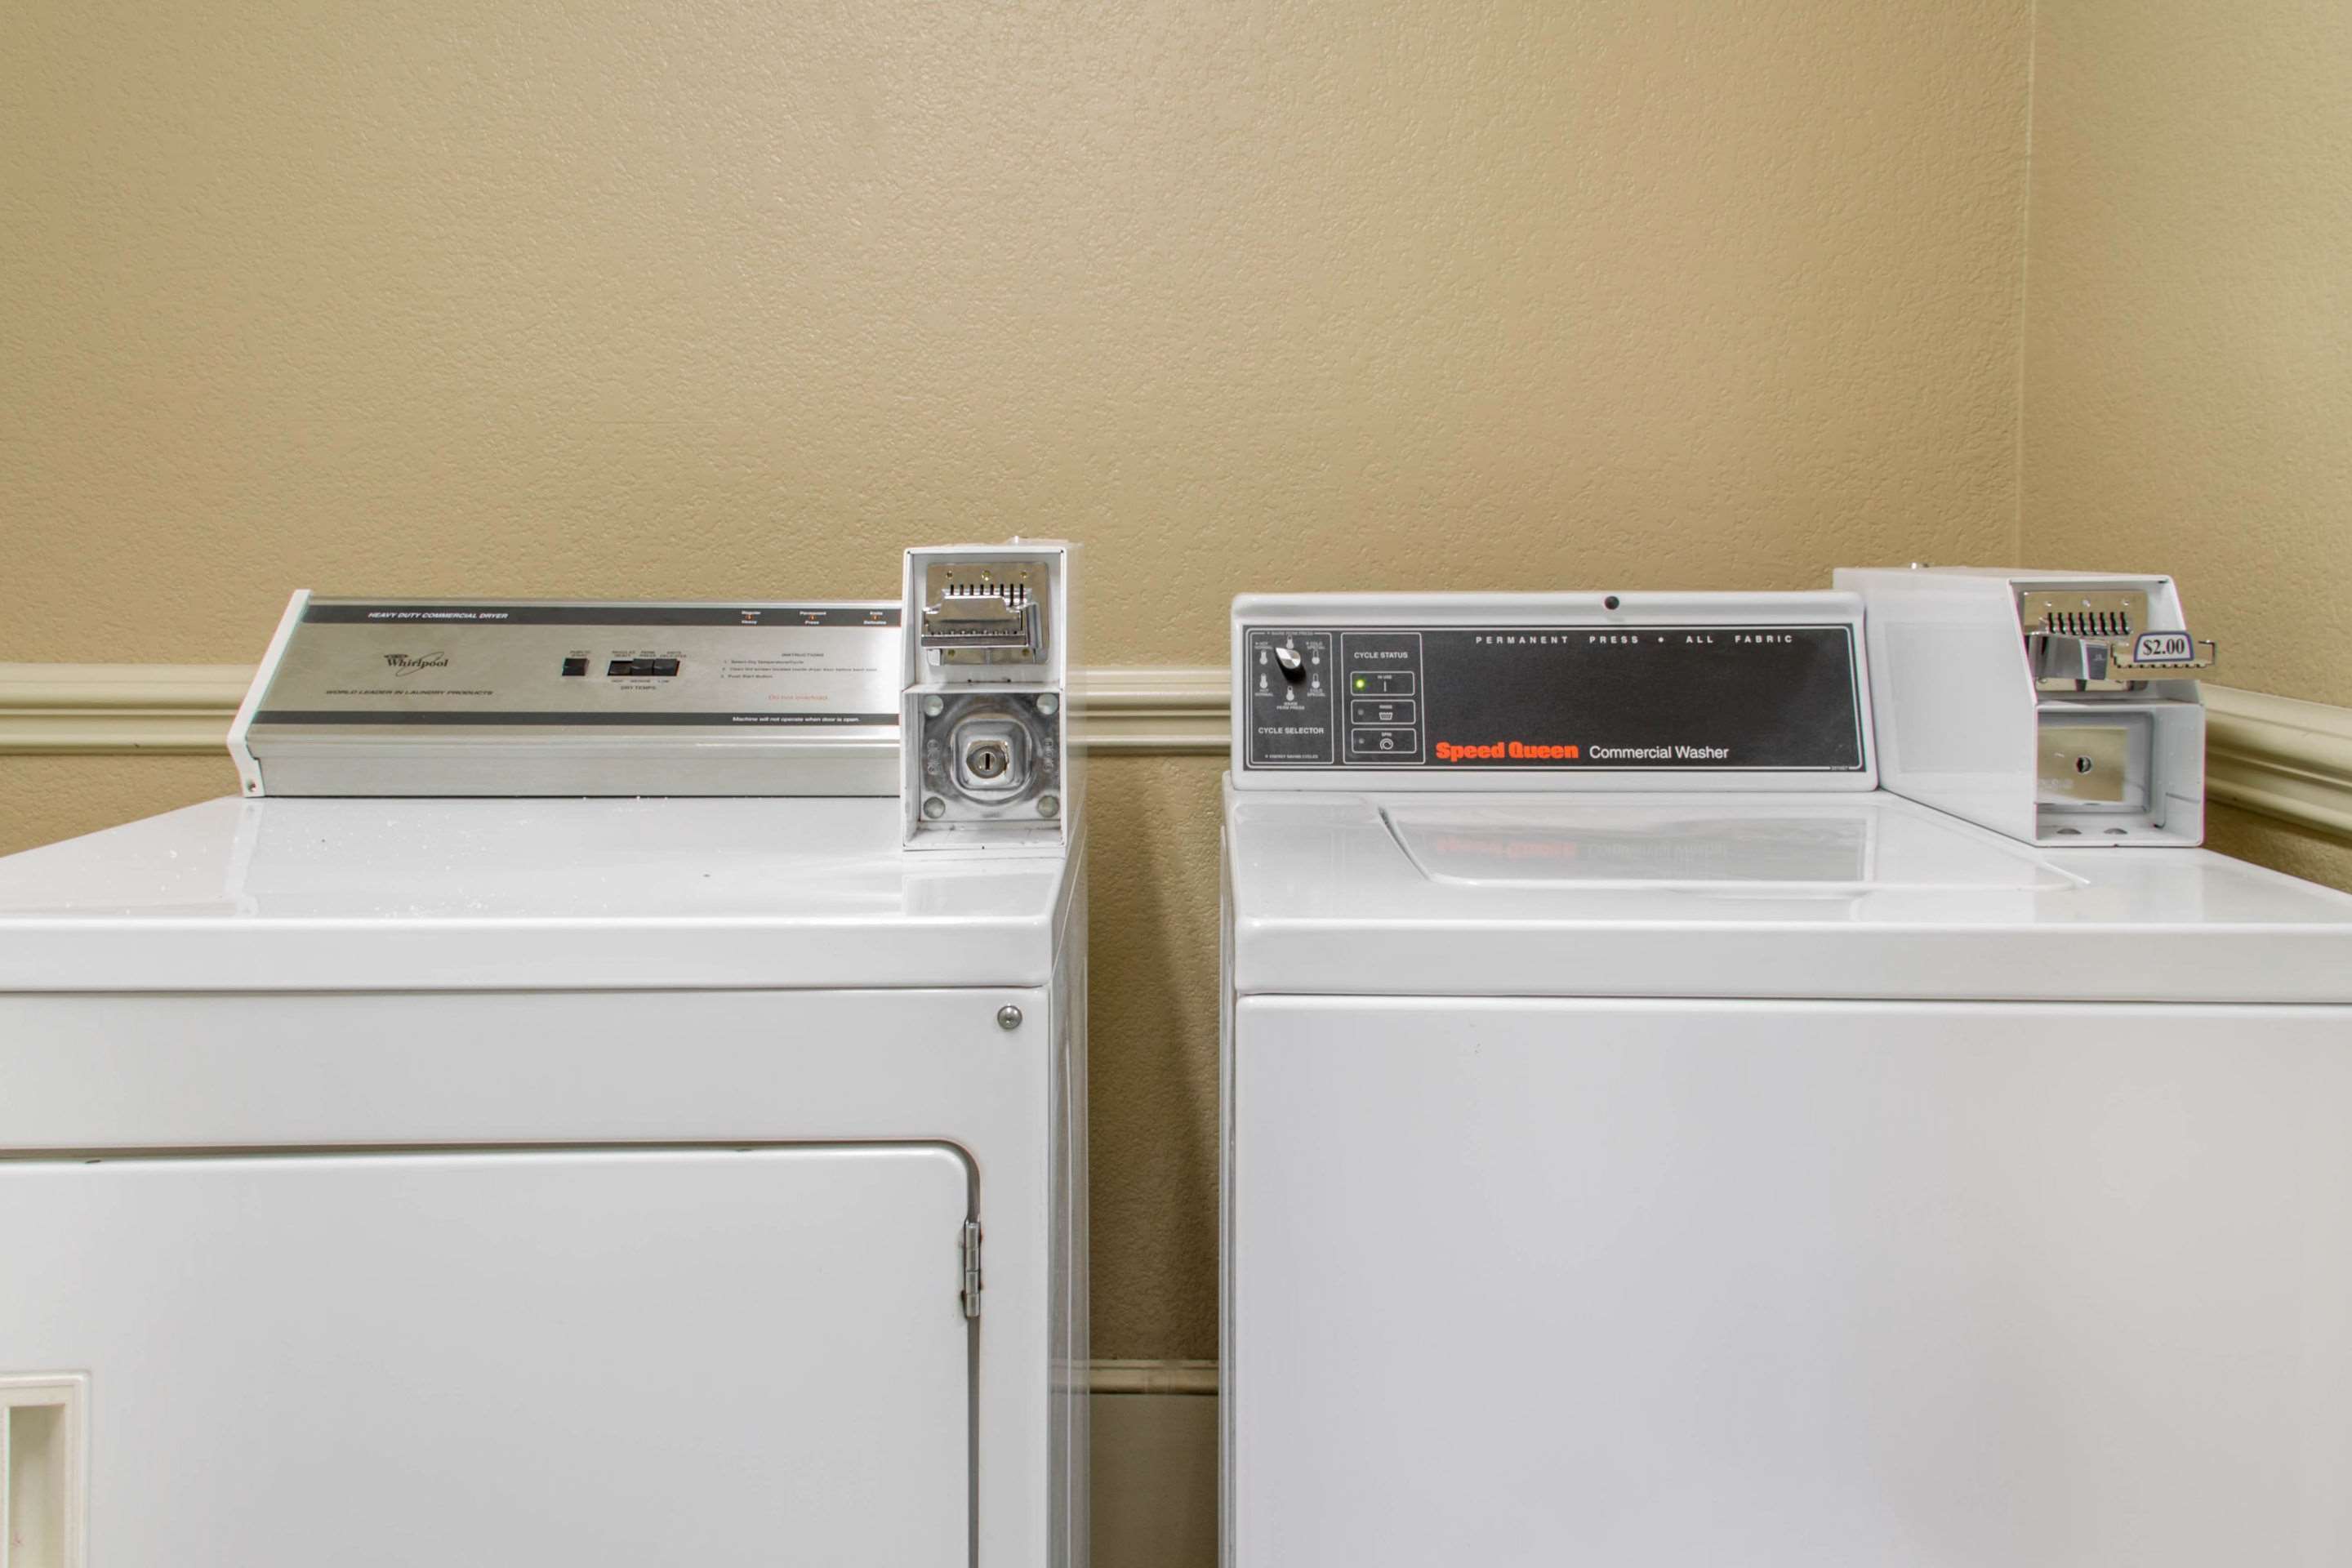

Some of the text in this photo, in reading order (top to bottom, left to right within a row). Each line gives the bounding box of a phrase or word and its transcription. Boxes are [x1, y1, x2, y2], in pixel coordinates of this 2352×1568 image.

[1476, 635, 1793, 644] PERMANENT PRESS ALL FABRIC
[2143, 639, 2185, 656] $2.00
[384, 655, 448, 669] Whirlpool
[1436, 742, 1579, 761] Speed Queen
[1589, 745, 1729, 759] Commercial Washer
